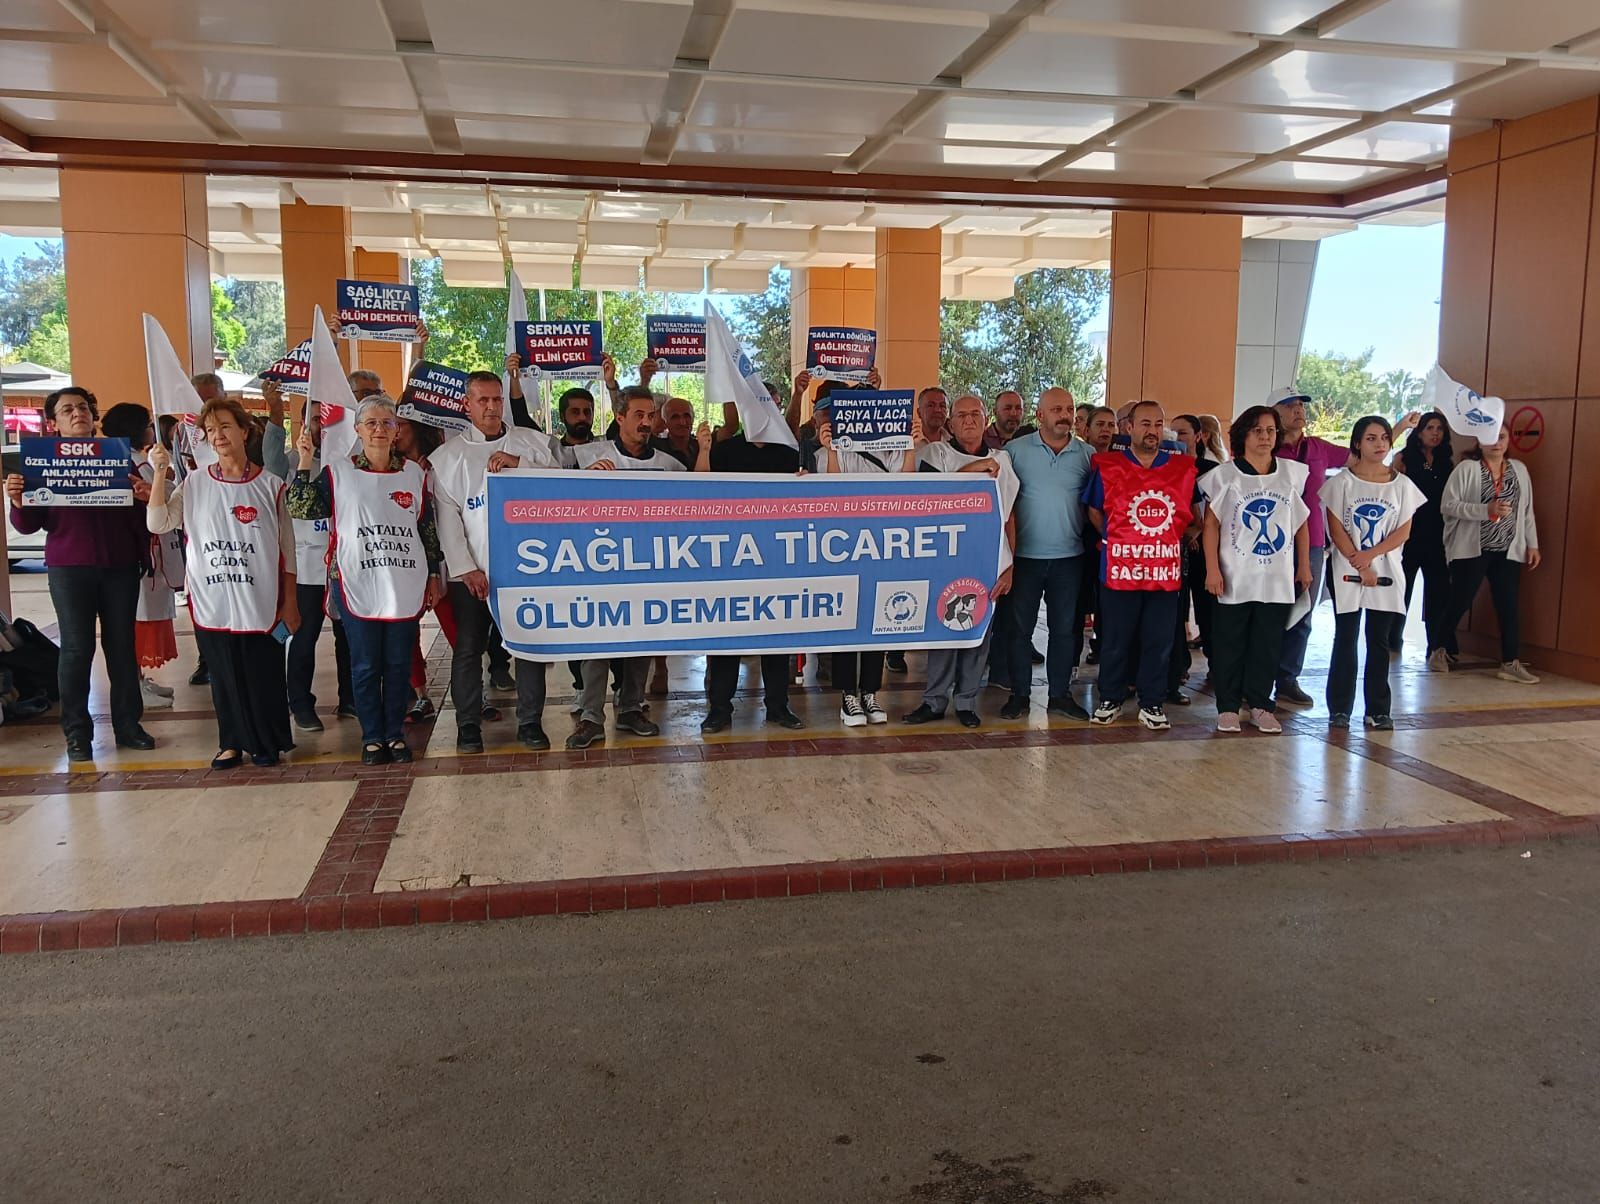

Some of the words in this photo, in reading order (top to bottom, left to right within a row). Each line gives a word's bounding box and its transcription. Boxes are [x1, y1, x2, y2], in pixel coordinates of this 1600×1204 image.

[346, 285, 412, 301] SAĞLIKTA
[351, 297, 407, 311] TİCARET
[341, 309, 369, 321] ÖLÜM
[526, 324, 591, 335] SERMAYE
[530, 337, 588, 348] SAĞLIKTAN
[671, 336, 699, 345] SAĞLIK
[654, 347, 688, 356] PARASIZ
[814, 342, 870, 353] SAĞLIKSIZLIK
[535, 350, 560, 362] ELİNİ
[562, 351, 586, 363] ÇEK!
[820, 354, 864, 366] ÜRETİYOR!
[427, 369, 463, 389] İKTİDAR
[409, 378, 454, 397] SERMAYEYİ
[414, 390, 440, 404] HALKI
[440, 398, 463, 412] GÖR!
[833, 399, 877, 407] SERMAYEYE
[877, 399, 897, 407] PARA
[898, 398, 911, 406] ÇOK
[835, 409, 871, 422] AŞIYA
[873, 407, 907, 420] İLACA
[837, 422, 873, 434] PARA
[877, 421, 907, 433] YOK!
[60, 442, 95, 456] SGK
[25, 456, 51, 466] ÖZEL
[52, 459, 129, 467] HASTANELERLE
[42, 469, 114, 478] ANLAŞMALARI
[46, 479, 76, 488] İPTAL
[78, 479, 110, 488] ETSİN!
[511, 505, 589, 518] SAĞLIKSIZLIK
[591, 505, 640, 517] ÜRETEN,
[643, 503, 733, 516] BEBEKLERİMİZİN
[735, 503, 778, 515] CANINA
[782, 502, 840, 514] KASTEDEN,
[843, 501, 858, 511] BU
[860, 499, 901, 511] SİSTEMİ
[903, 497, 986, 512] DEĞİŞTİRECEĞİZ!
[1138, 505, 1167, 518] DİSK
[356, 525, 414, 539] ANTALYA
[203, 540, 255, 554] ANTALYA
[365, 539, 411, 554] ÇAĞDAŞ
[516, 528, 764, 575] SAĞLIKTA
[775, 522, 967, 565] TİCARET
[515, 597, 632, 630] ÖLÜM
[643, 588, 844, 625] DEMEKTİR!
